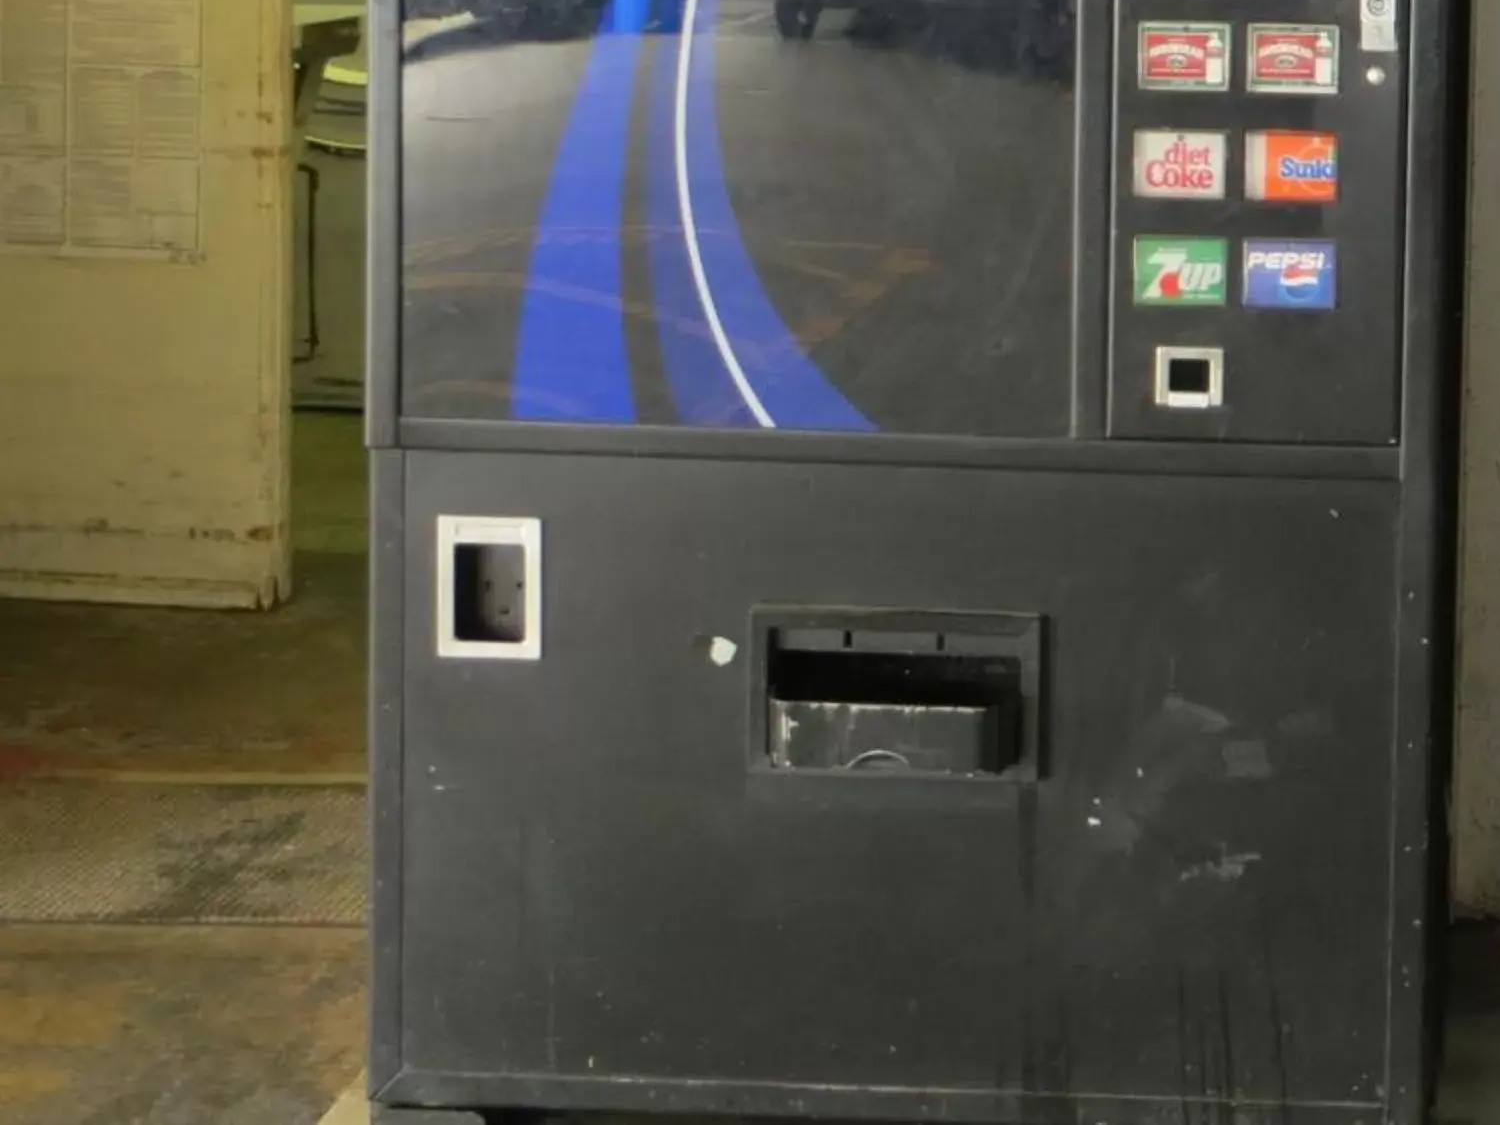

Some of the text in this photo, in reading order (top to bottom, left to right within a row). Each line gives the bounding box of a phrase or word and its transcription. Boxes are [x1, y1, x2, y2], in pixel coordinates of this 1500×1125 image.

[1164, 141, 1211, 167] diet
[1145, 160, 1214, 190] Coke
[1248, 250, 1325, 269] PEPSI
